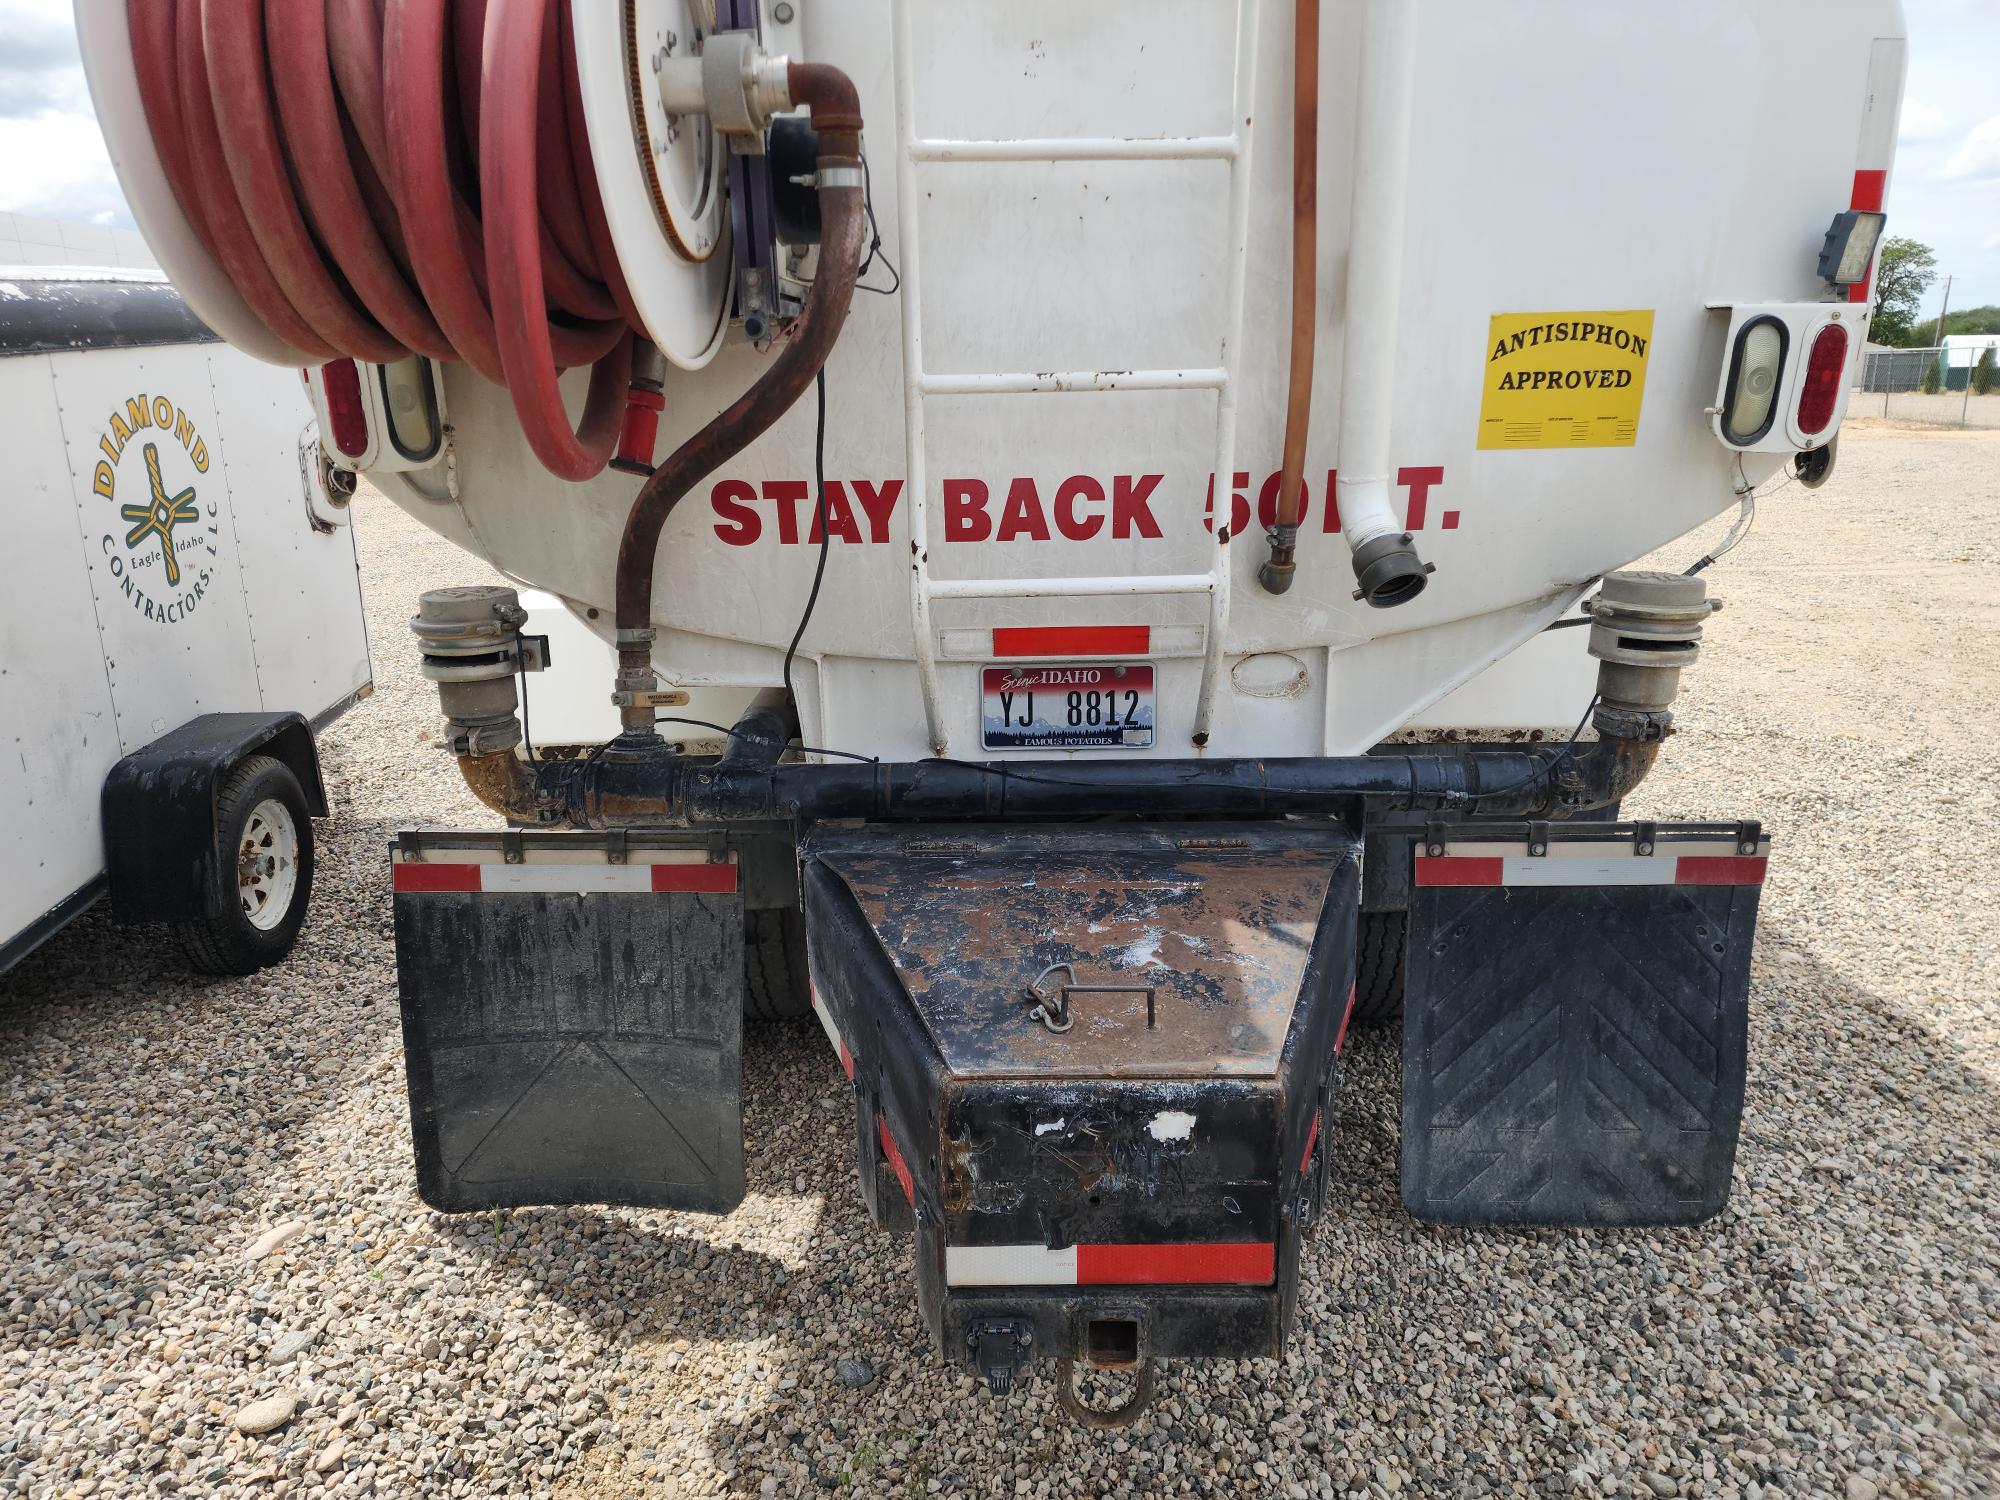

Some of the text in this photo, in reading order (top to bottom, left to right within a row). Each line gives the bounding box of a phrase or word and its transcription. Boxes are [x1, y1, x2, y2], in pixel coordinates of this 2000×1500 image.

[1490, 322, 1647, 362] ANTISIPHON
[1498, 369, 1632, 391] APPROVED
[93, 394, 210, 501] DIAMOND
[711, 479, 904, 546] STAY
[943, 475, 1164, 542] BACK
[206, 502, 218, 557] LLC
[131, 536, 204, 569] Eagle Idaho
[1001, 670, 1101, 691] Scenic IDAHO
[1000, 690, 1139, 727] YJ 8812
[1024, 737, 1113, 746] FAMOUS POTATOES
